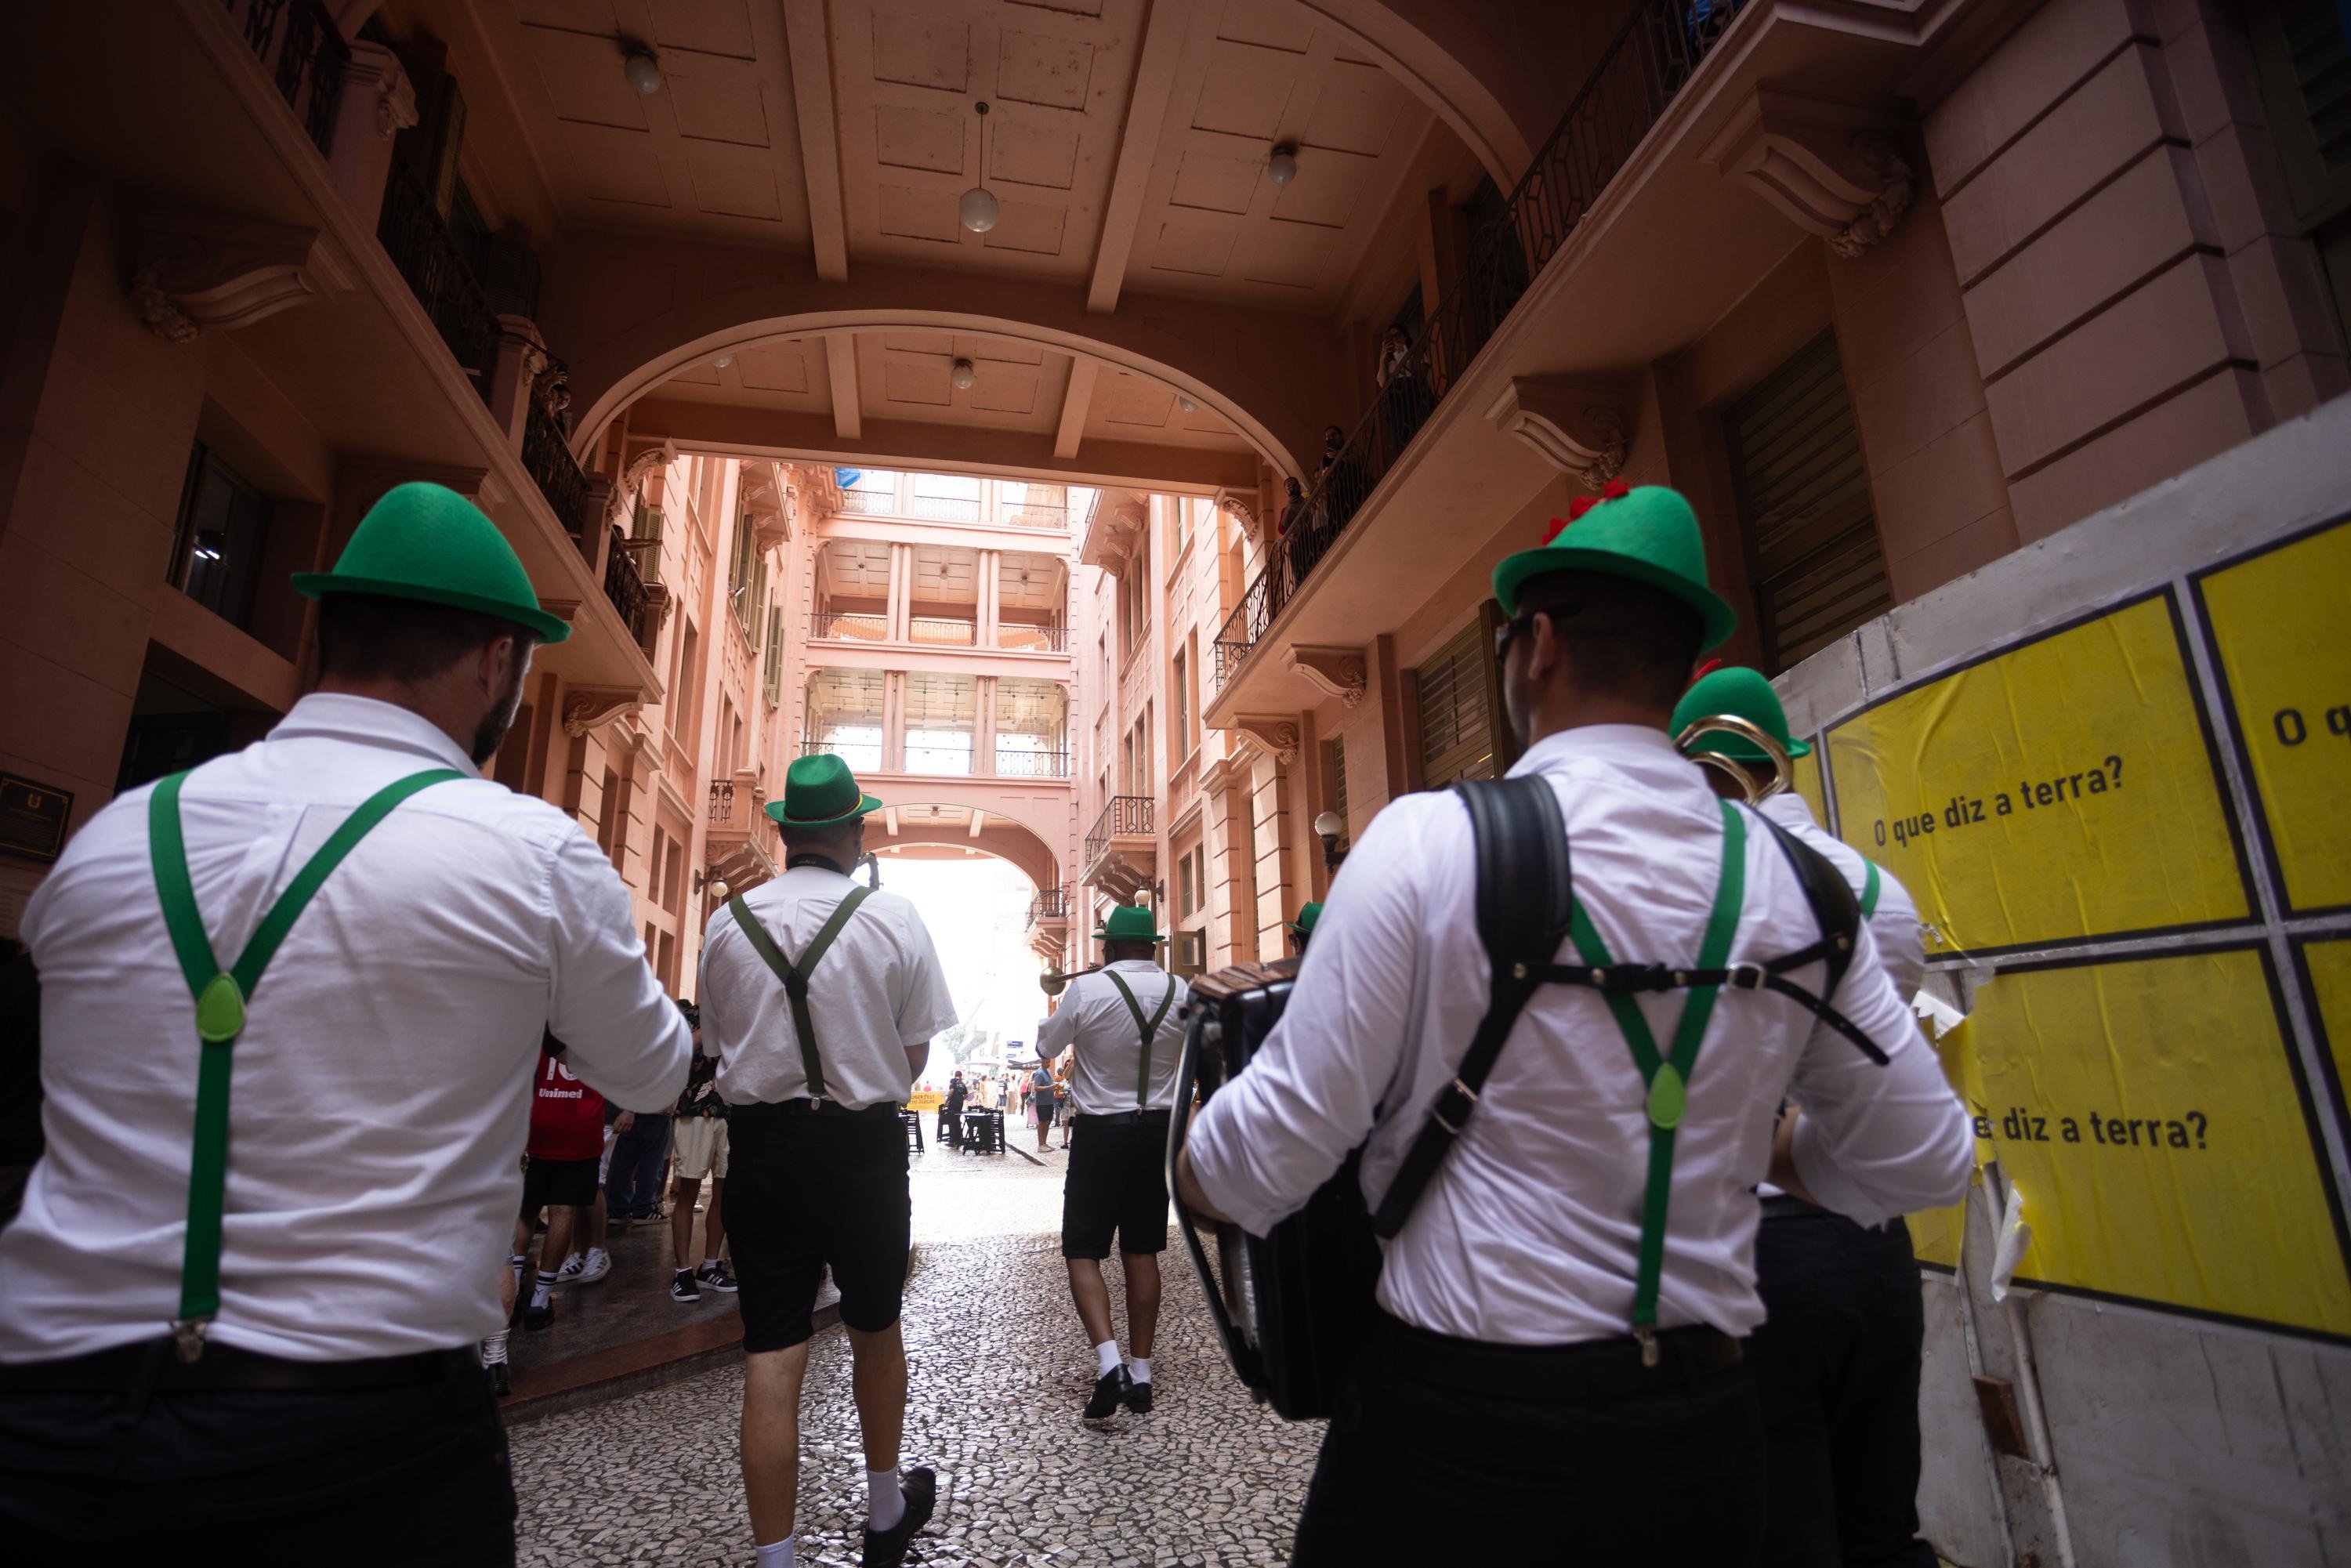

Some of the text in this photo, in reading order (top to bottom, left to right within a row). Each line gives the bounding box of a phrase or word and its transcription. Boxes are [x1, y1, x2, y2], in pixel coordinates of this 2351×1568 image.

[2273, 708, 2306, 747] O
[1874, 755, 2122, 847] O que diz a terra?
[538, 1088, 583, 1099] Unimed
[2002, 1107, 2049, 1141] diz
[2060, 1117, 2081, 1143] a
[2089, 1110, 2207, 1150] terra?
